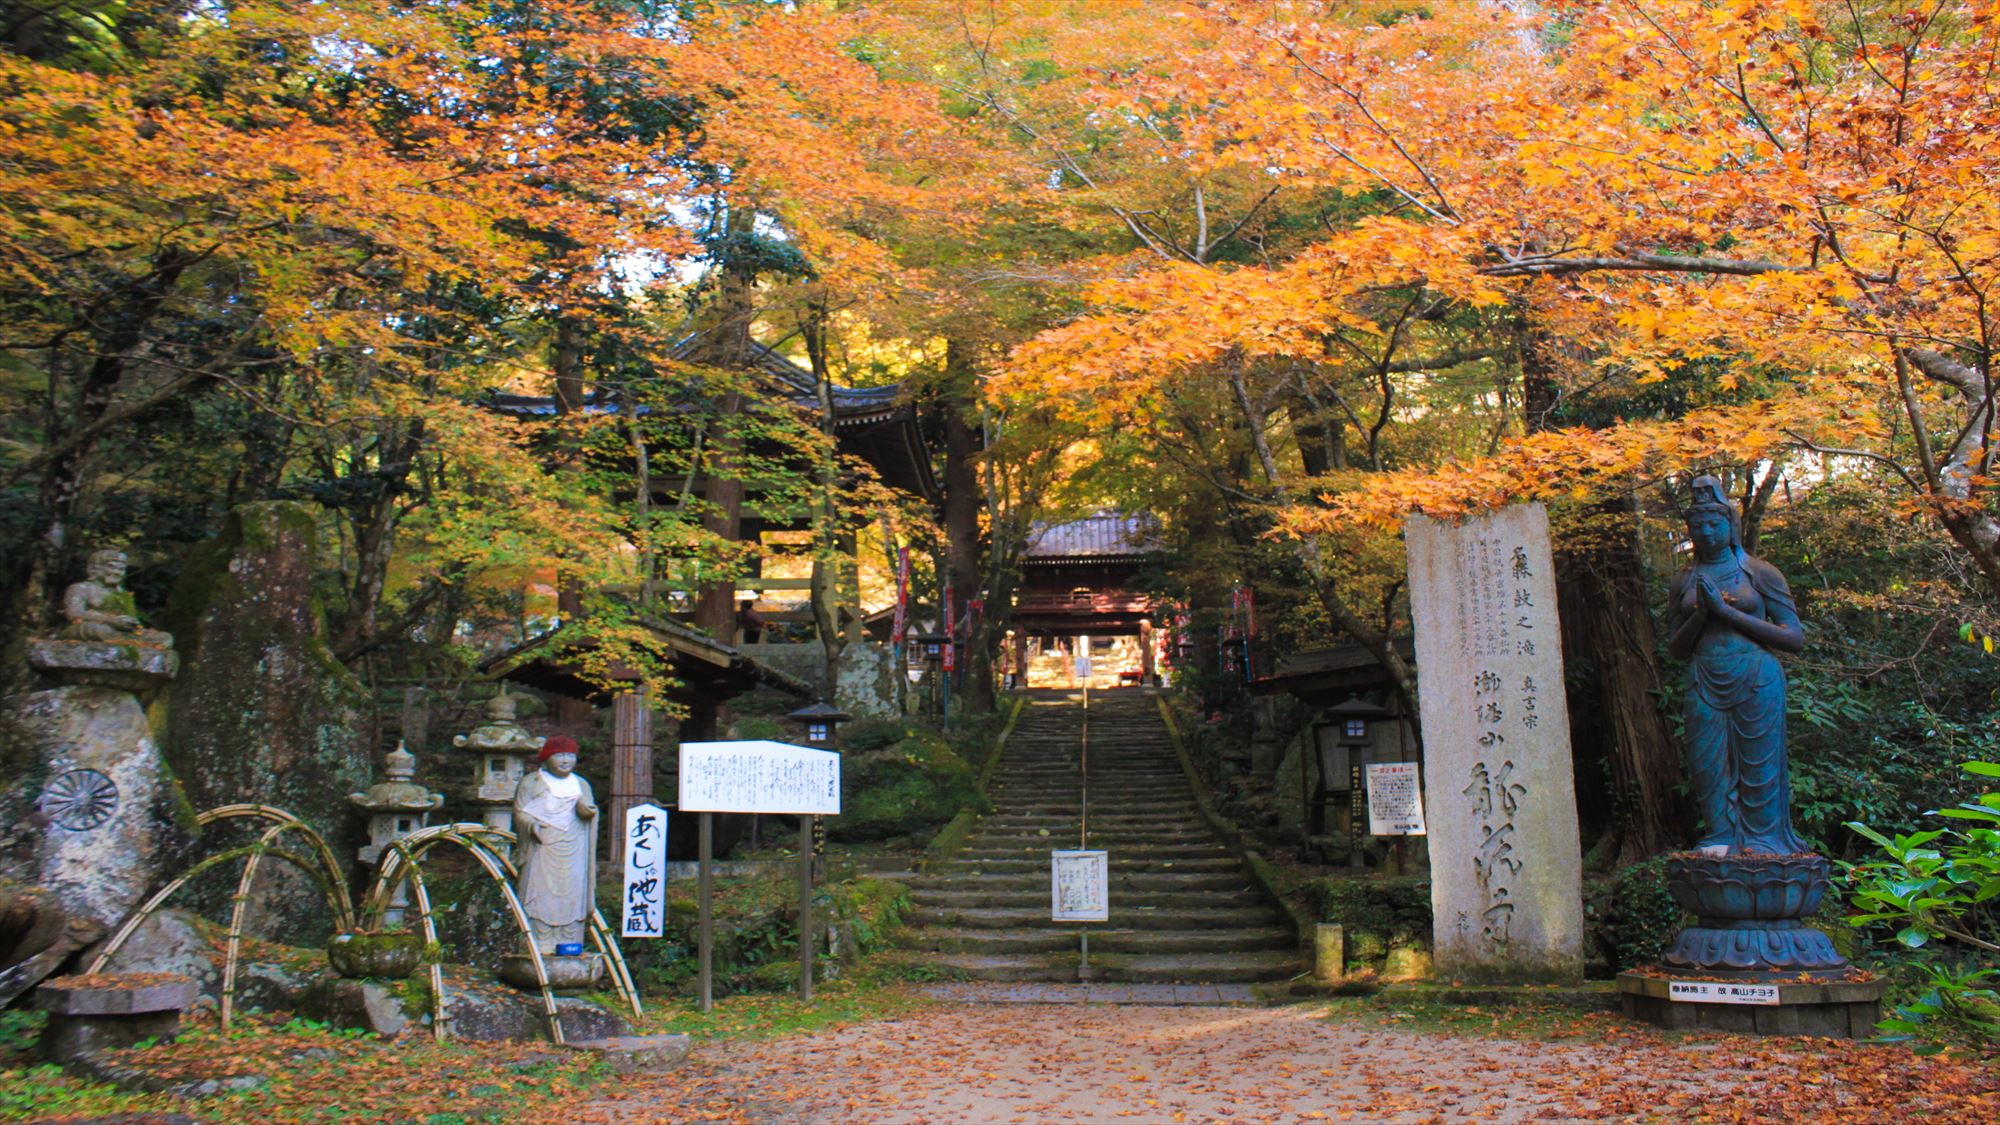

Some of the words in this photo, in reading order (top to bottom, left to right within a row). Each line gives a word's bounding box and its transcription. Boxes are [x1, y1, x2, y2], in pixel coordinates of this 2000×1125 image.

[1519, 675, 1539, 729] 真言宗
[626, 814, 661, 933] あくしゅ地蔵
[1731, 987, 1775, 997] 高山チヨ子
